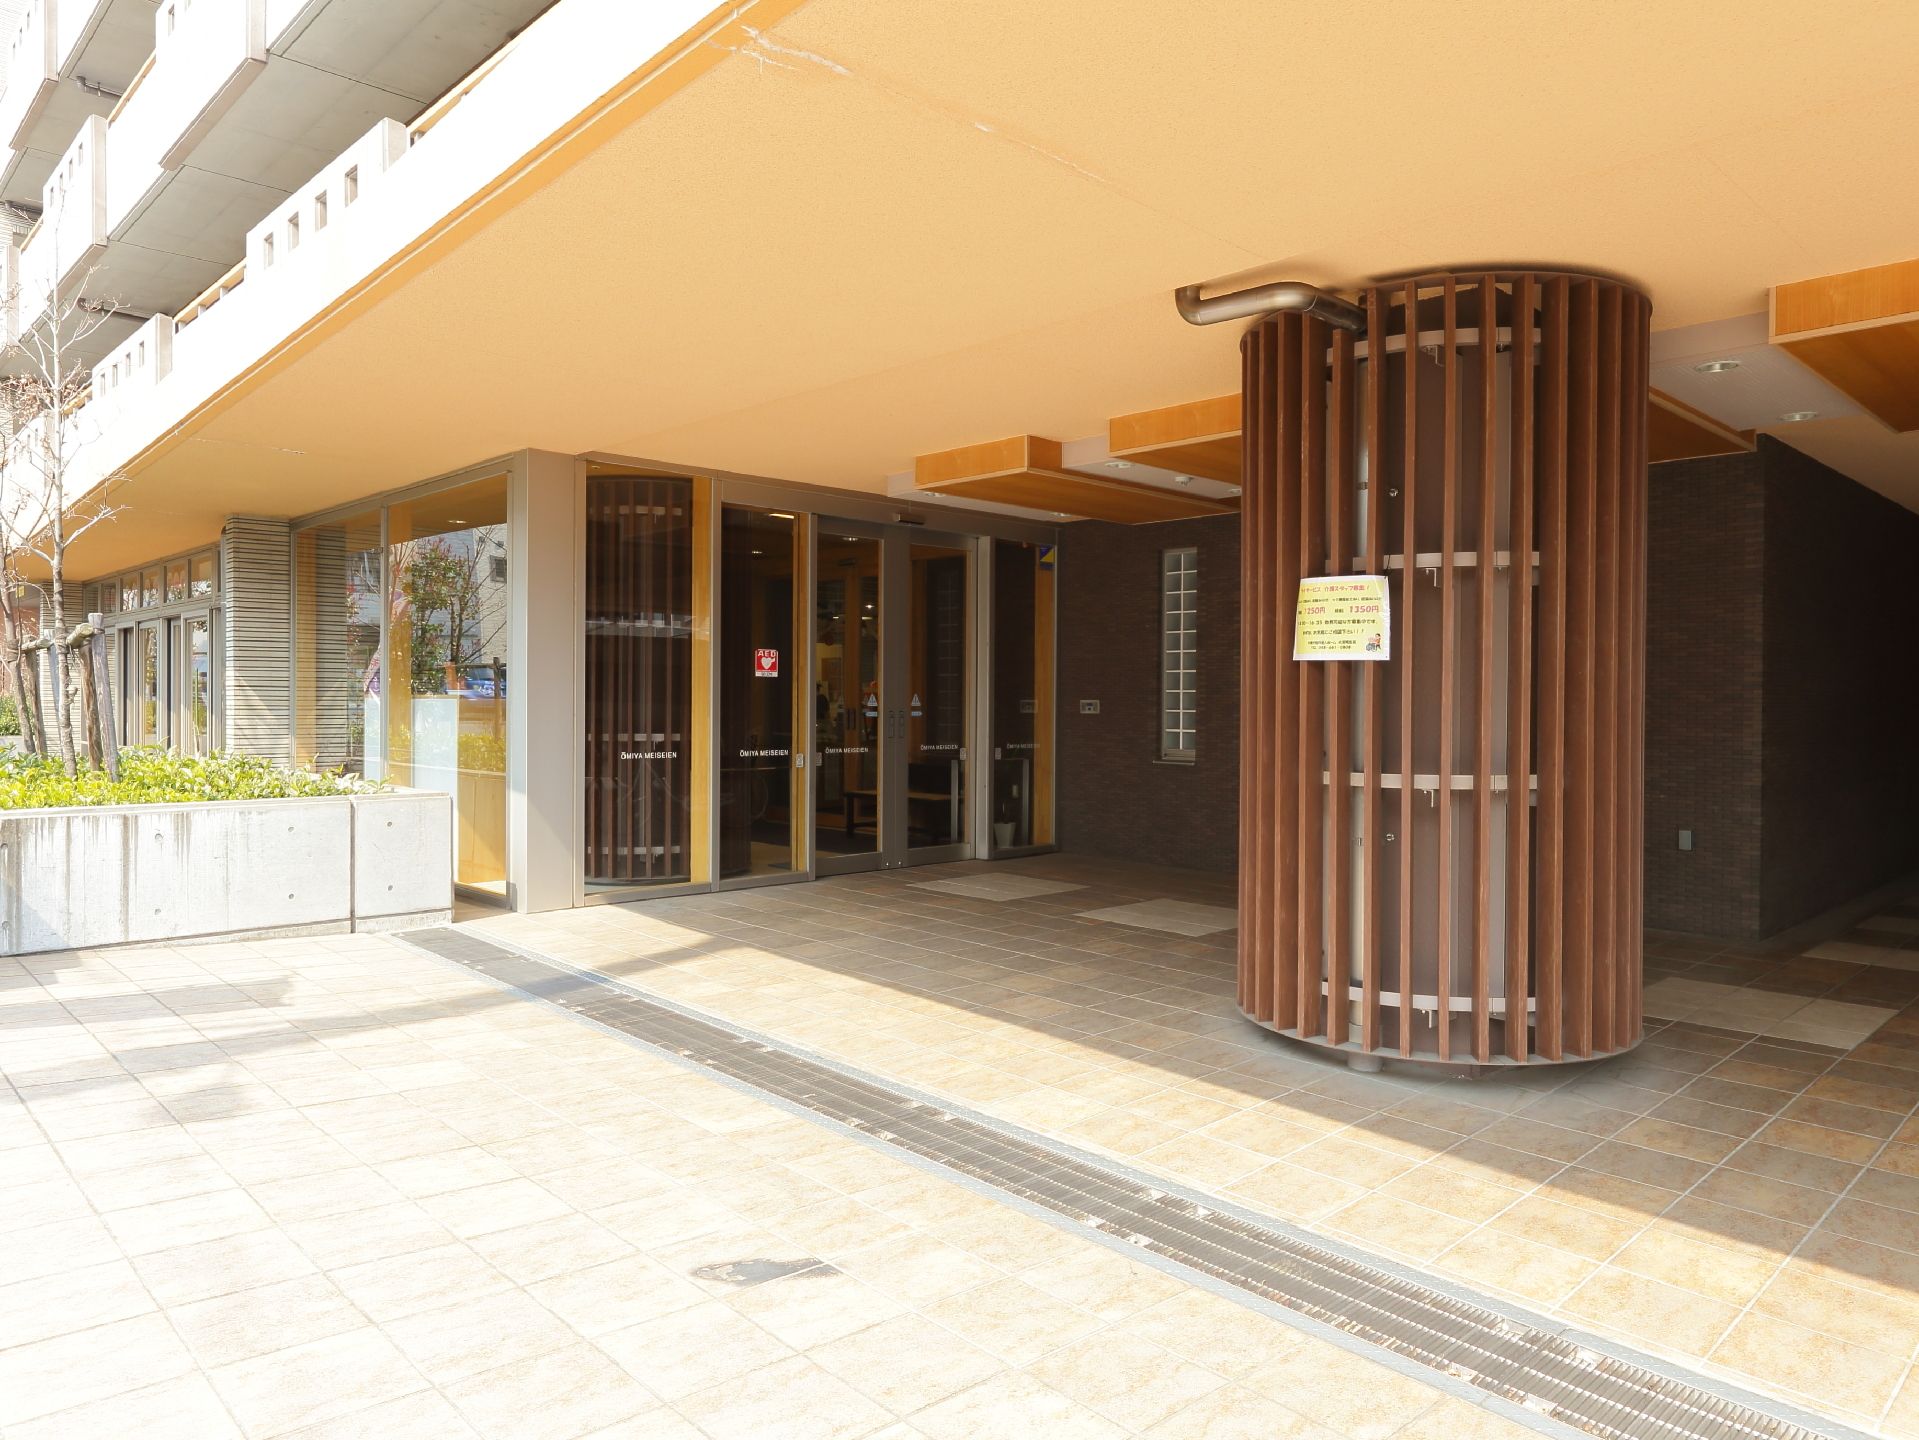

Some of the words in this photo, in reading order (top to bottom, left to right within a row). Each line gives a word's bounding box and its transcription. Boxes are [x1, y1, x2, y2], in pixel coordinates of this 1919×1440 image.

[1349, 604, 1380, 613] 1350円
[757, 650, 777, 658] AED
[644, 751, 677, 759] MEISEIEN
[760, 749, 789, 757] MEISEIEN
